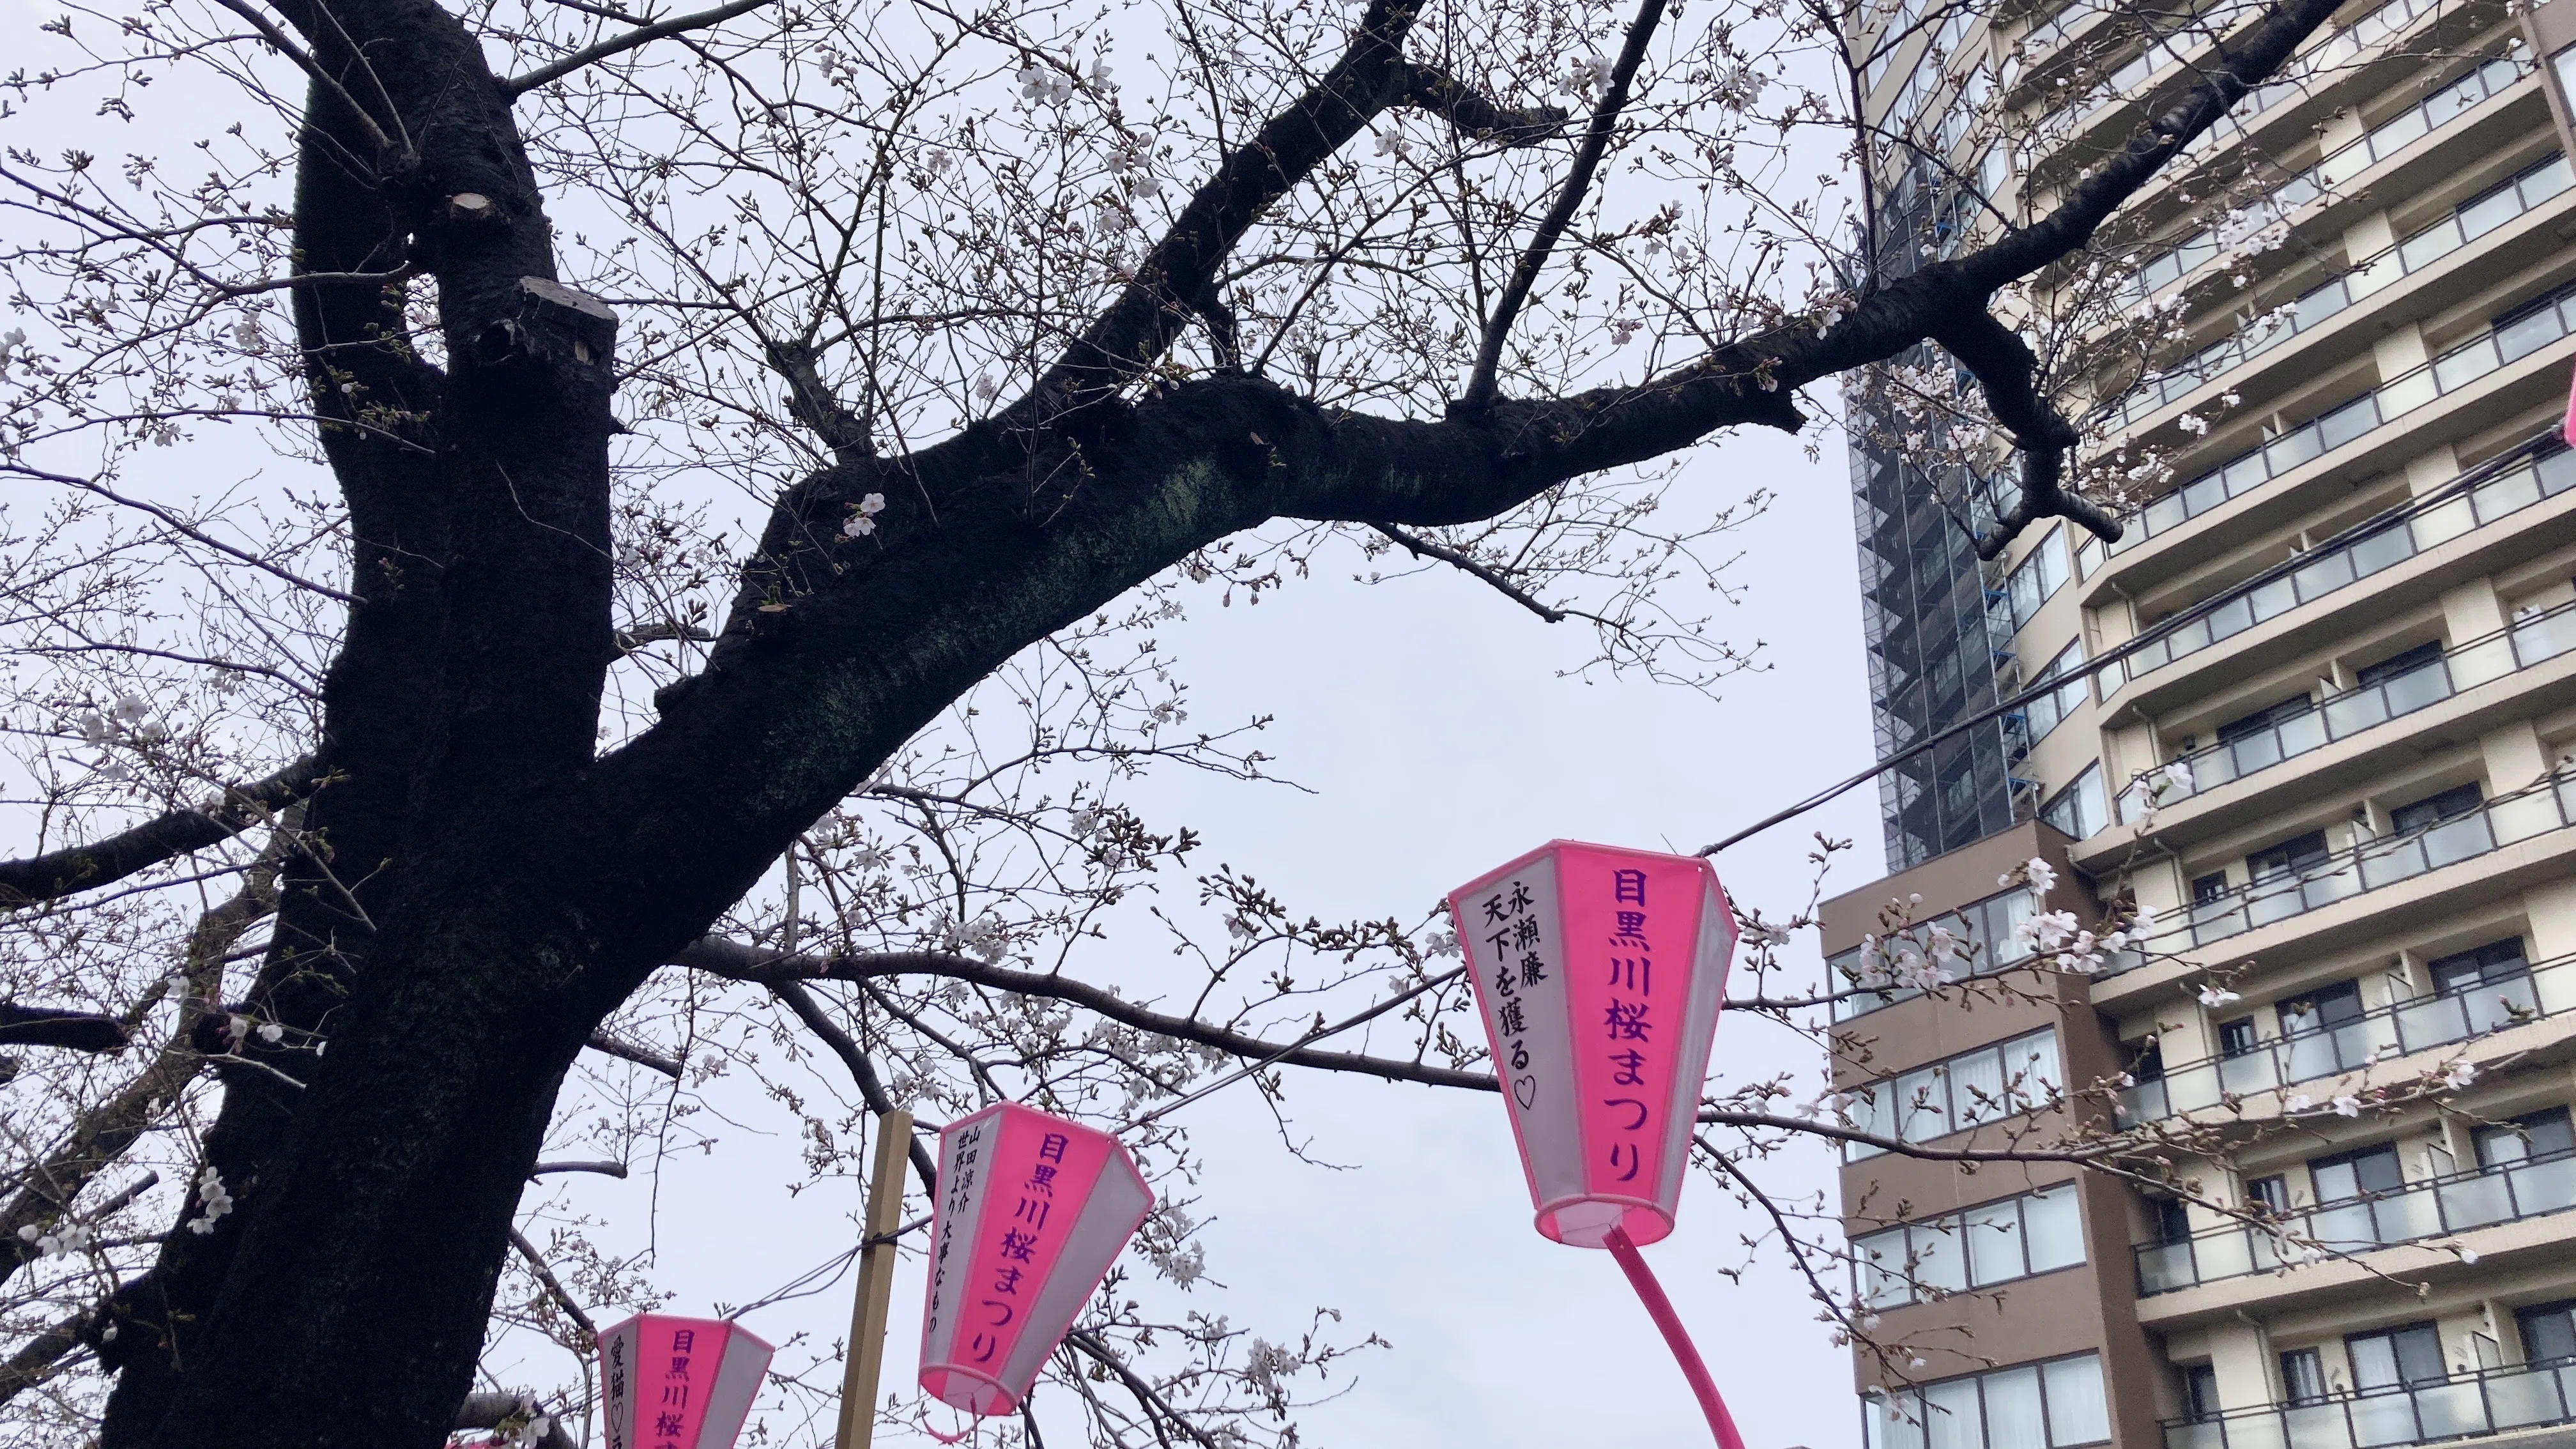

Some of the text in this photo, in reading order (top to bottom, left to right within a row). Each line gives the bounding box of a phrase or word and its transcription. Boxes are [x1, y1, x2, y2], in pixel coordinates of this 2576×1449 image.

[1508, 880, 1549, 990] 永瀬廉
[1604, 868, 1653, 1182] 目黒川桜まつり
[928, 1130, 970, 1333] 世界より大事なもの
[957, 1125, 981, 1215] 山田涼介
[972, 1132, 1070, 1363] 目黒川桜まつり
[654, 1329, 695, 1449] 目黒川桜
